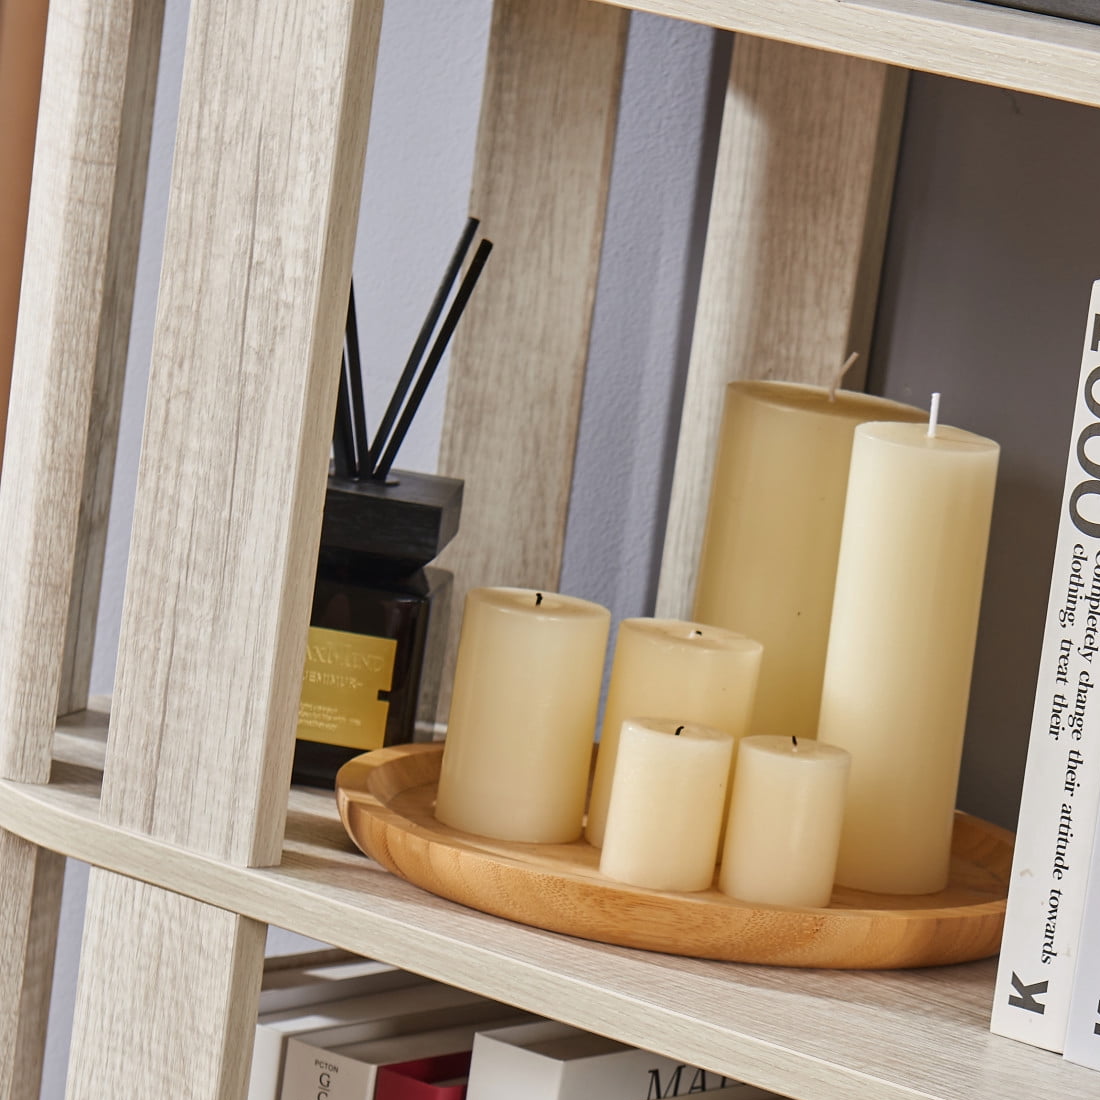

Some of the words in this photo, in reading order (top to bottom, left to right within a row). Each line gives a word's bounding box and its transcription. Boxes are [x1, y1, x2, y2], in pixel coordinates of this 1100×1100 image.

[1055, 637, 1074, 685] treat
[1048, 693, 1068, 740] their
[1070, 669, 1094, 741] change
[1063, 748, 1083, 797] their
[1053, 803, 1073, 880] attitude
[1041, 888, 1063, 964] towards
[1008, 971, 1049, 1016] K
[314, 1059, 339, 1074] PCTON
[319, 1072, 331, 1088] G
